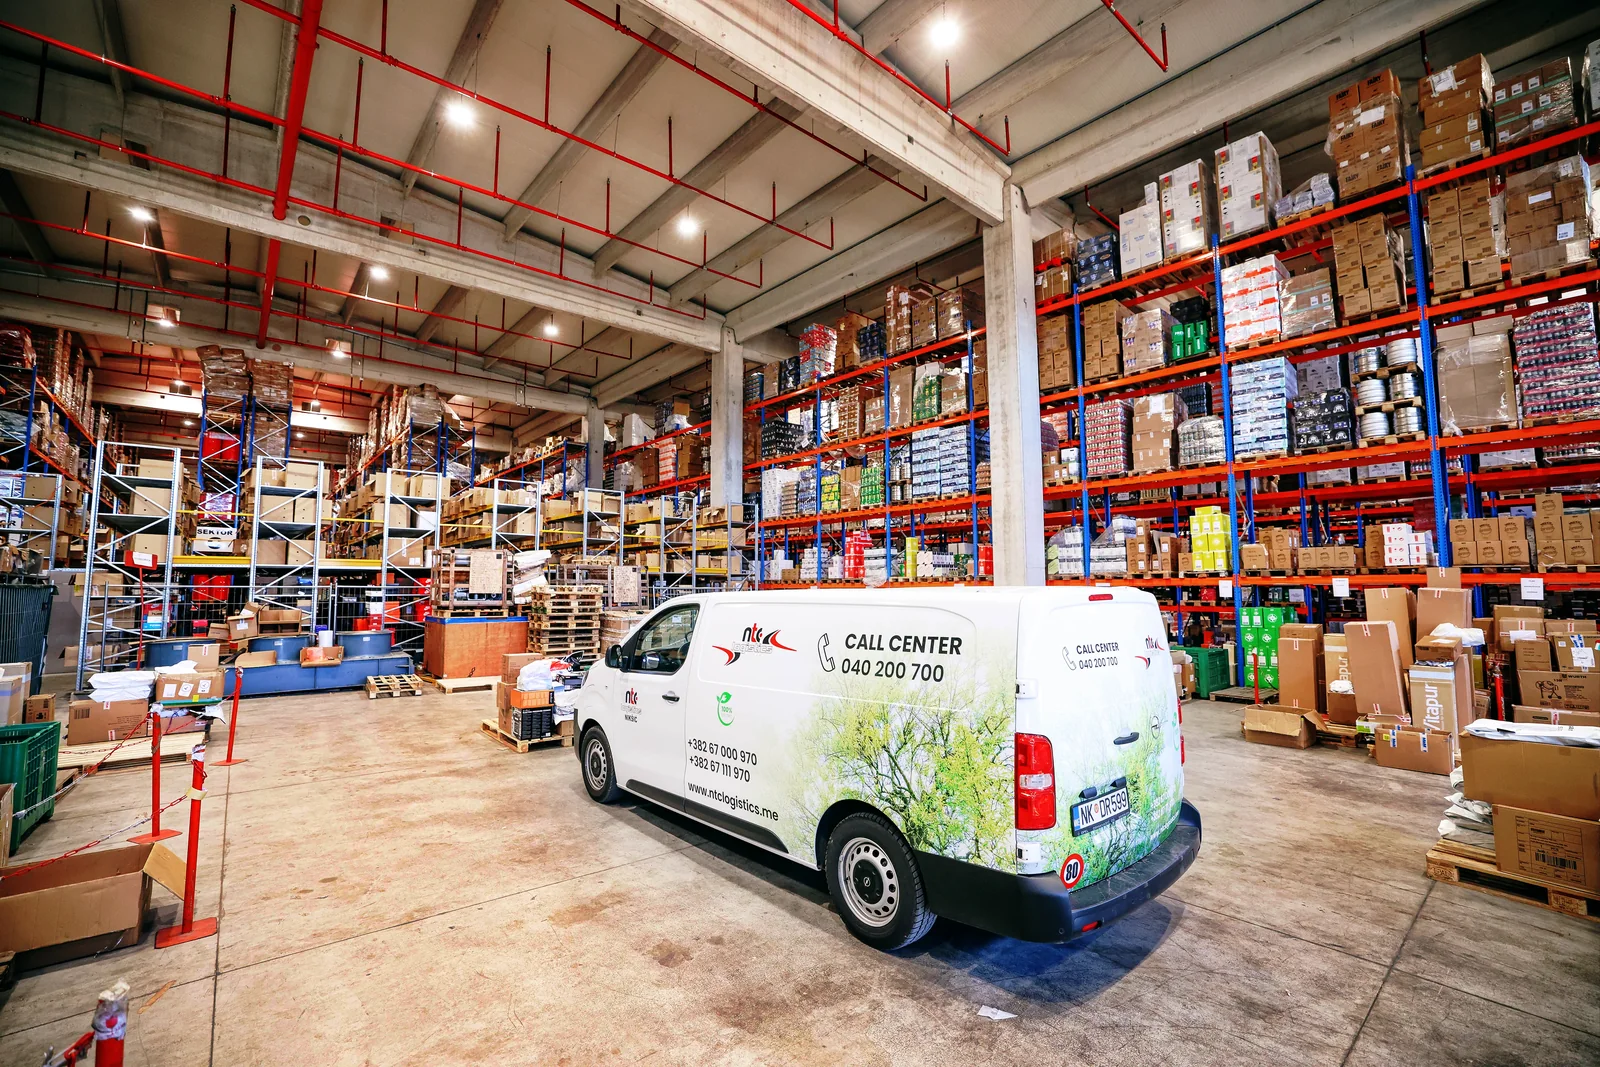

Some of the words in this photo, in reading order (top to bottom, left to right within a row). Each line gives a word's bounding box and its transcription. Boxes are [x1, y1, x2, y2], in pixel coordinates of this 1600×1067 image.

[732, 641, 773, 654] logistics
[845, 633, 884, 651] CALL
[889, 634, 962, 655] CENTER
[1076, 643, 1095, 655] CALL
[1095, 642, 1119, 654] CENTER
[841, 658, 871, 676] 040
[874, 660, 906, 679] 200
[911, 663, 944, 683] 700
[1078, 659, 1093, 670] 040
[1094, 658, 1106, 668] 200
[1107, 656, 1118, 666] 700
[688, 738, 708, 753] +382
[708, 742, 719, 755] 67
[720, 745, 738, 760] 000
[740, 750, 757, 766] 970
[689, 755, 709, 770] +382
[710, 760, 720, 773] 67
[721, 763, 732, 777] 111
[733, 767, 751, 782] 970
[688, 782, 779, 821] www.ntclogistics.me
[1080, 803, 1095, 825] NK
[1100, 791, 1127, 818] DR599
[1065, 861, 1079, 881] 80
